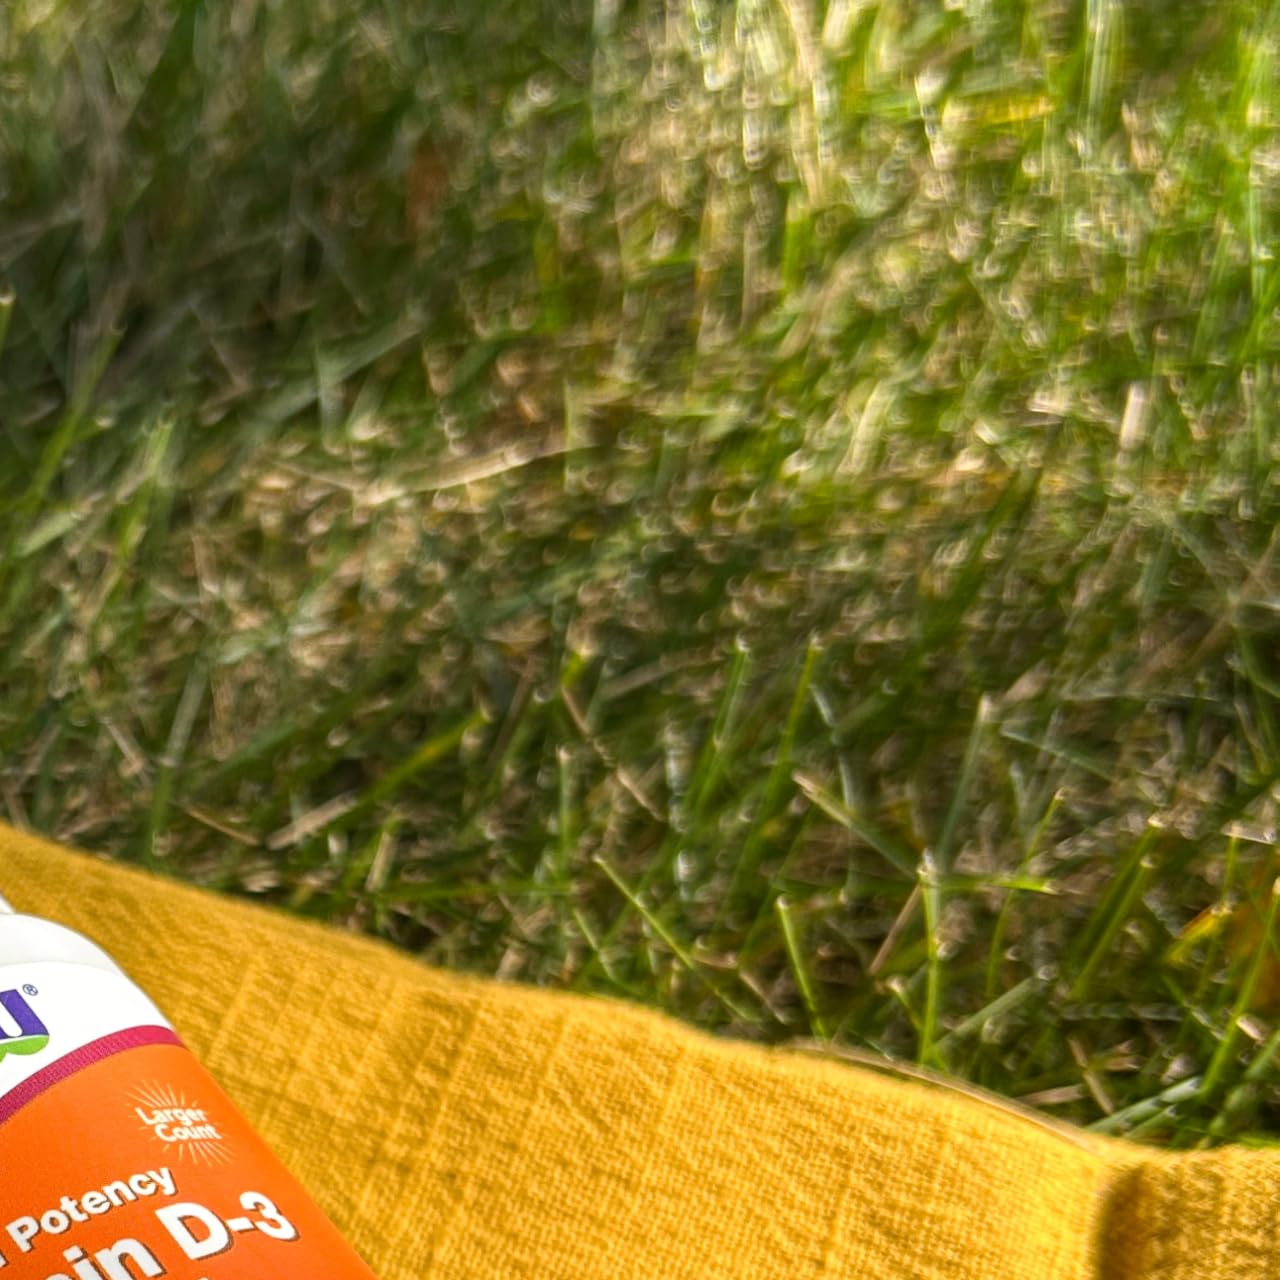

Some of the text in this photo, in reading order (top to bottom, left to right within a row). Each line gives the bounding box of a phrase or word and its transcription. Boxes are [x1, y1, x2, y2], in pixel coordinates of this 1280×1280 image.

[135, 1107, 208, 1126] Larger
[154, 1123, 223, 1142] Count
[5, 1166, 178, 1254] Potency
[154, 1191, 300, 1262] D-3
